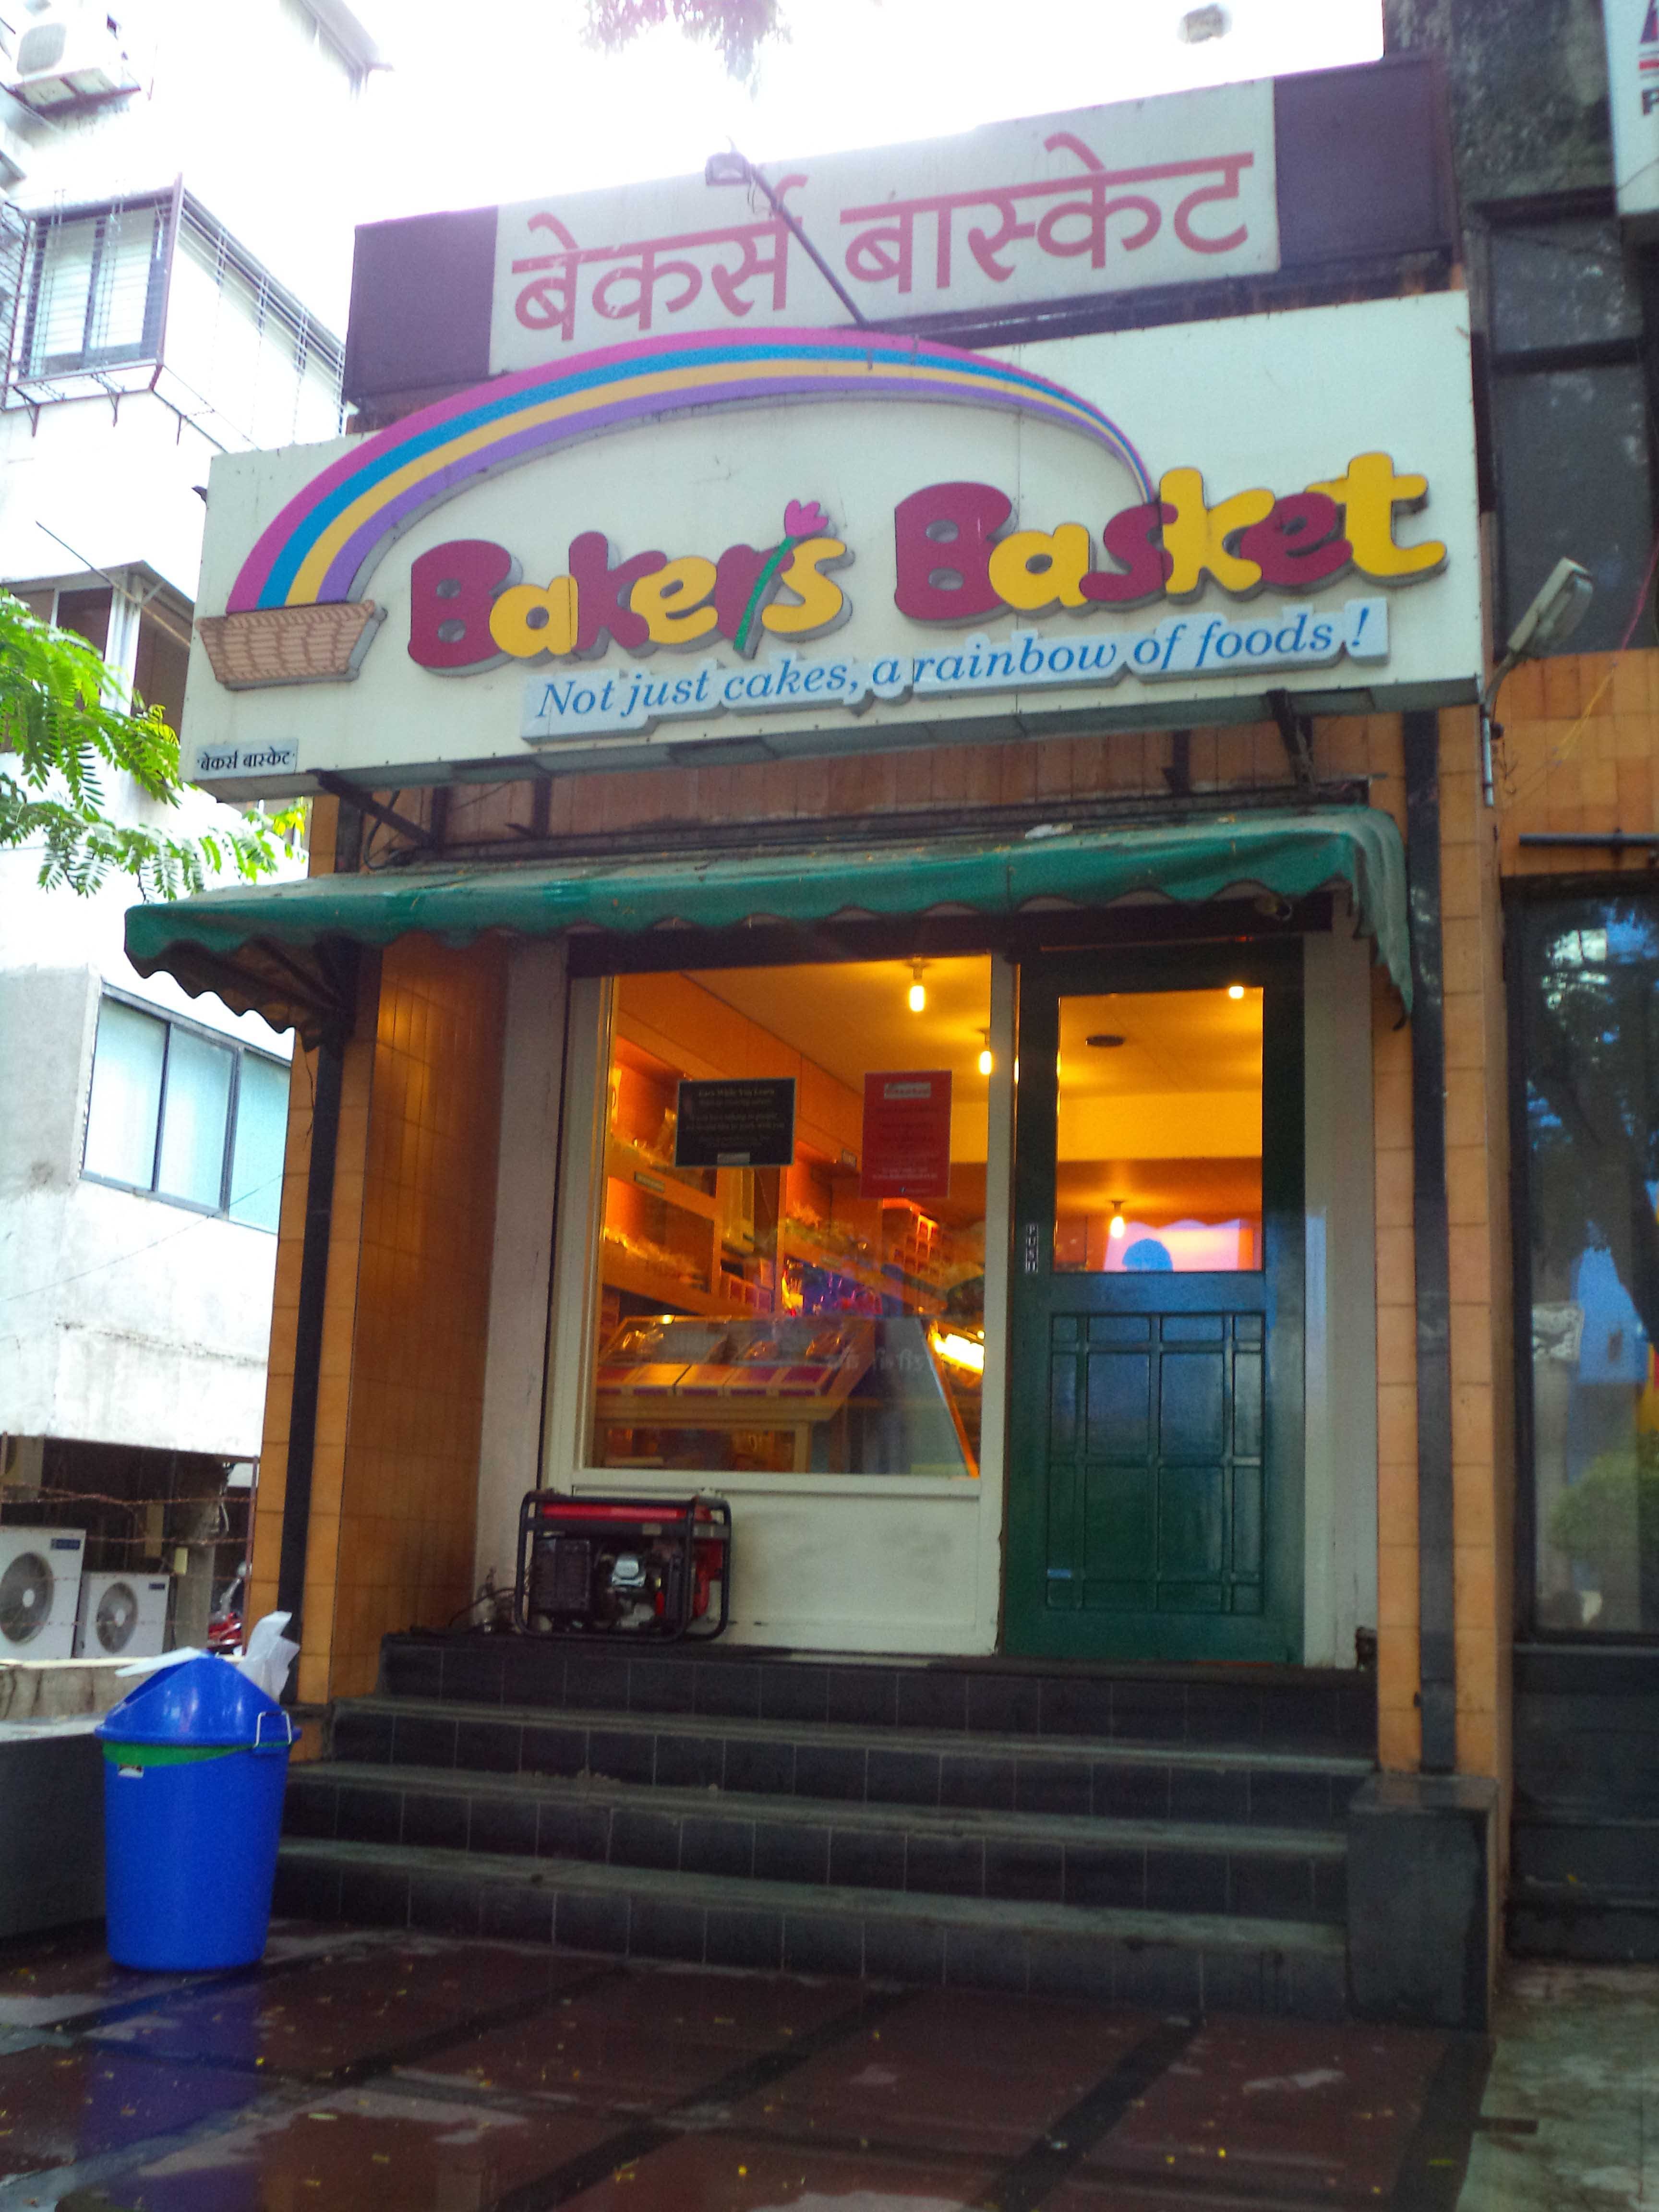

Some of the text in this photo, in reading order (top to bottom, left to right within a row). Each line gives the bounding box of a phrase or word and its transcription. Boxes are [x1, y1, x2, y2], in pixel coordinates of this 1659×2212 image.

[512, 132, 1254, 342] बेकर्स बास्केट
[894, 453, 1447, 620] Basket
[535, 680, 614, 717] Not
[620, 669, 709, 718] just
[724, 658, 858, 700] cakes,
[873, 659, 901, 685] a
[913, 637, 1117, 683] rainbow
[1134, 623, 1187, 670] of
